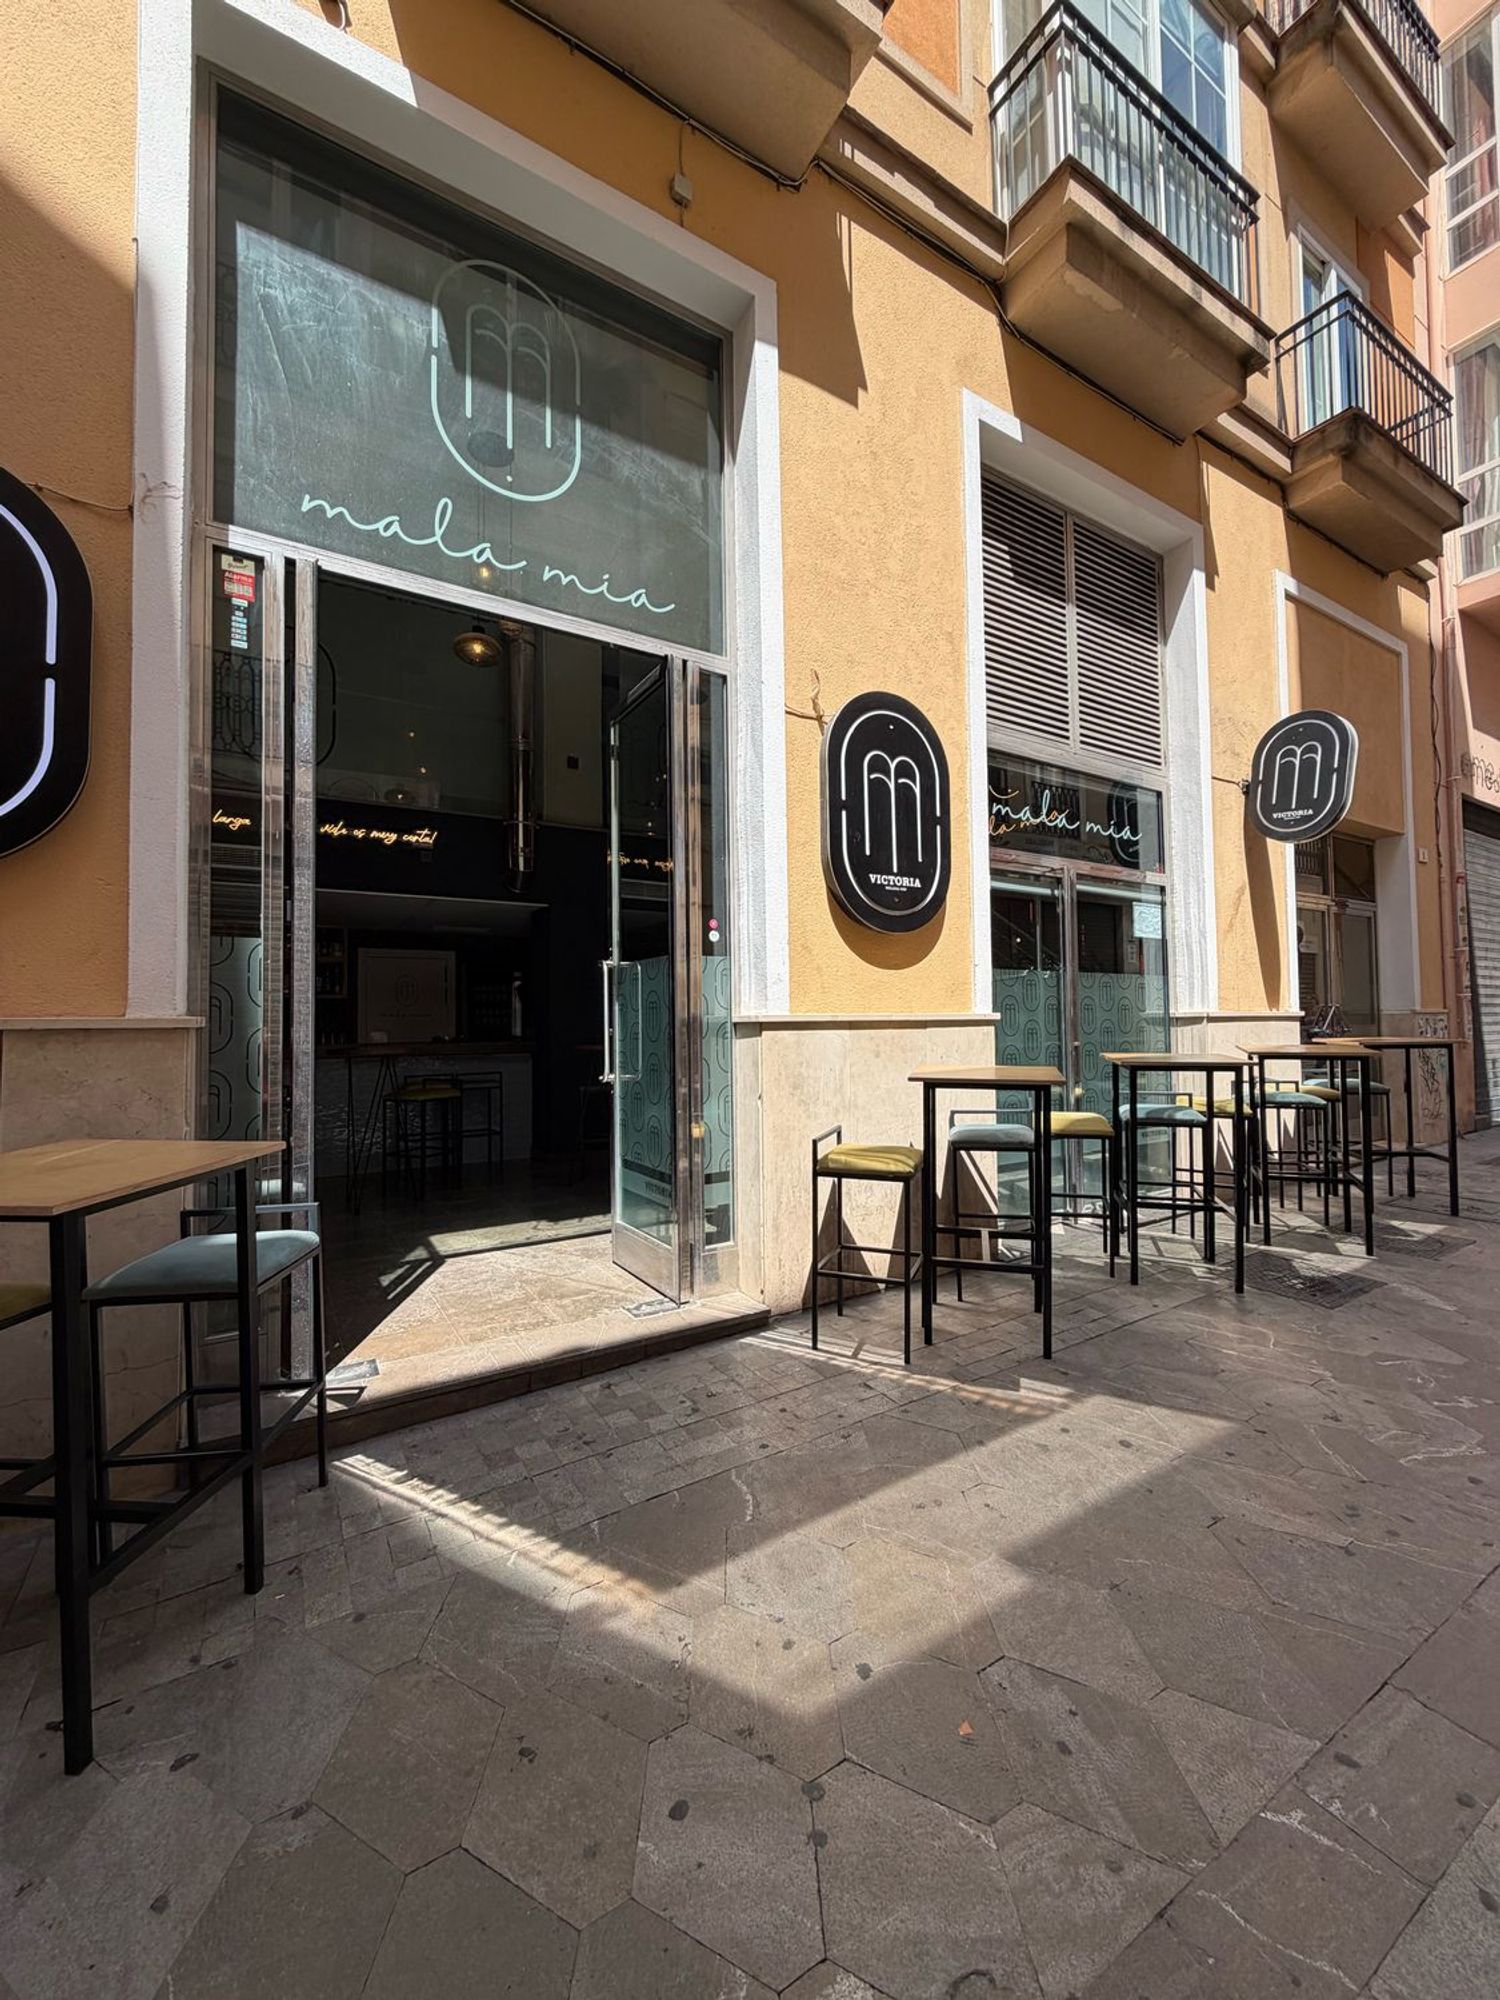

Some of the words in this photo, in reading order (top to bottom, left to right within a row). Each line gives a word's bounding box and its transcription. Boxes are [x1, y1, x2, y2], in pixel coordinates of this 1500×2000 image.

[301, 494, 528, 571] mala
[543, 565, 676, 613] mia
[992, 789, 1080, 829] mala
[1086, 820, 1143, 841] mia
[1272, 808, 1314, 819] VICTORIA
[370, 830, 399, 845] muy
[868, 873, 922, 888] VICTORIA
